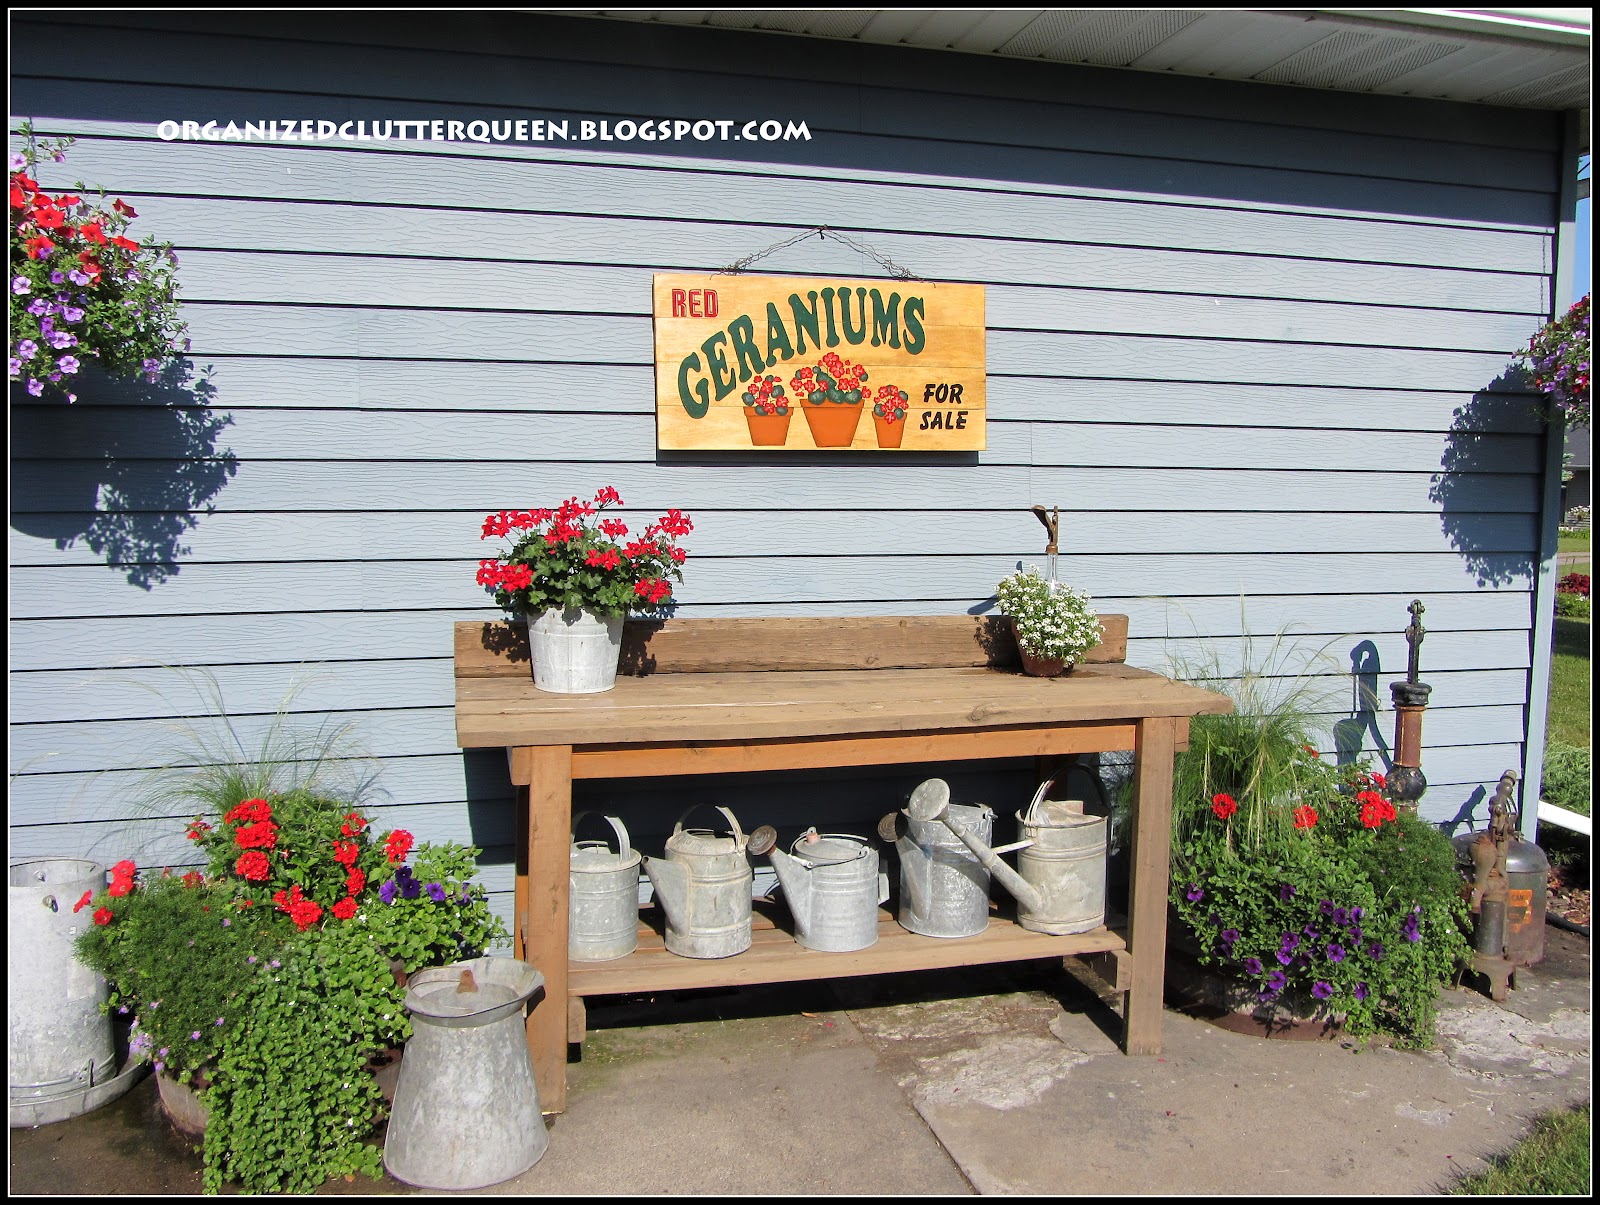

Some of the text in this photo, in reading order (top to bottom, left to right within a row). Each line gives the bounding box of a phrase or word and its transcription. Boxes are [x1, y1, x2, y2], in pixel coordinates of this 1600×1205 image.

[671, 288, 719, 318] RED
[677, 286, 926, 419] GERANIUMS
[923, 383, 963, 404] FOR
[919, 411, 968, 430] SALE
